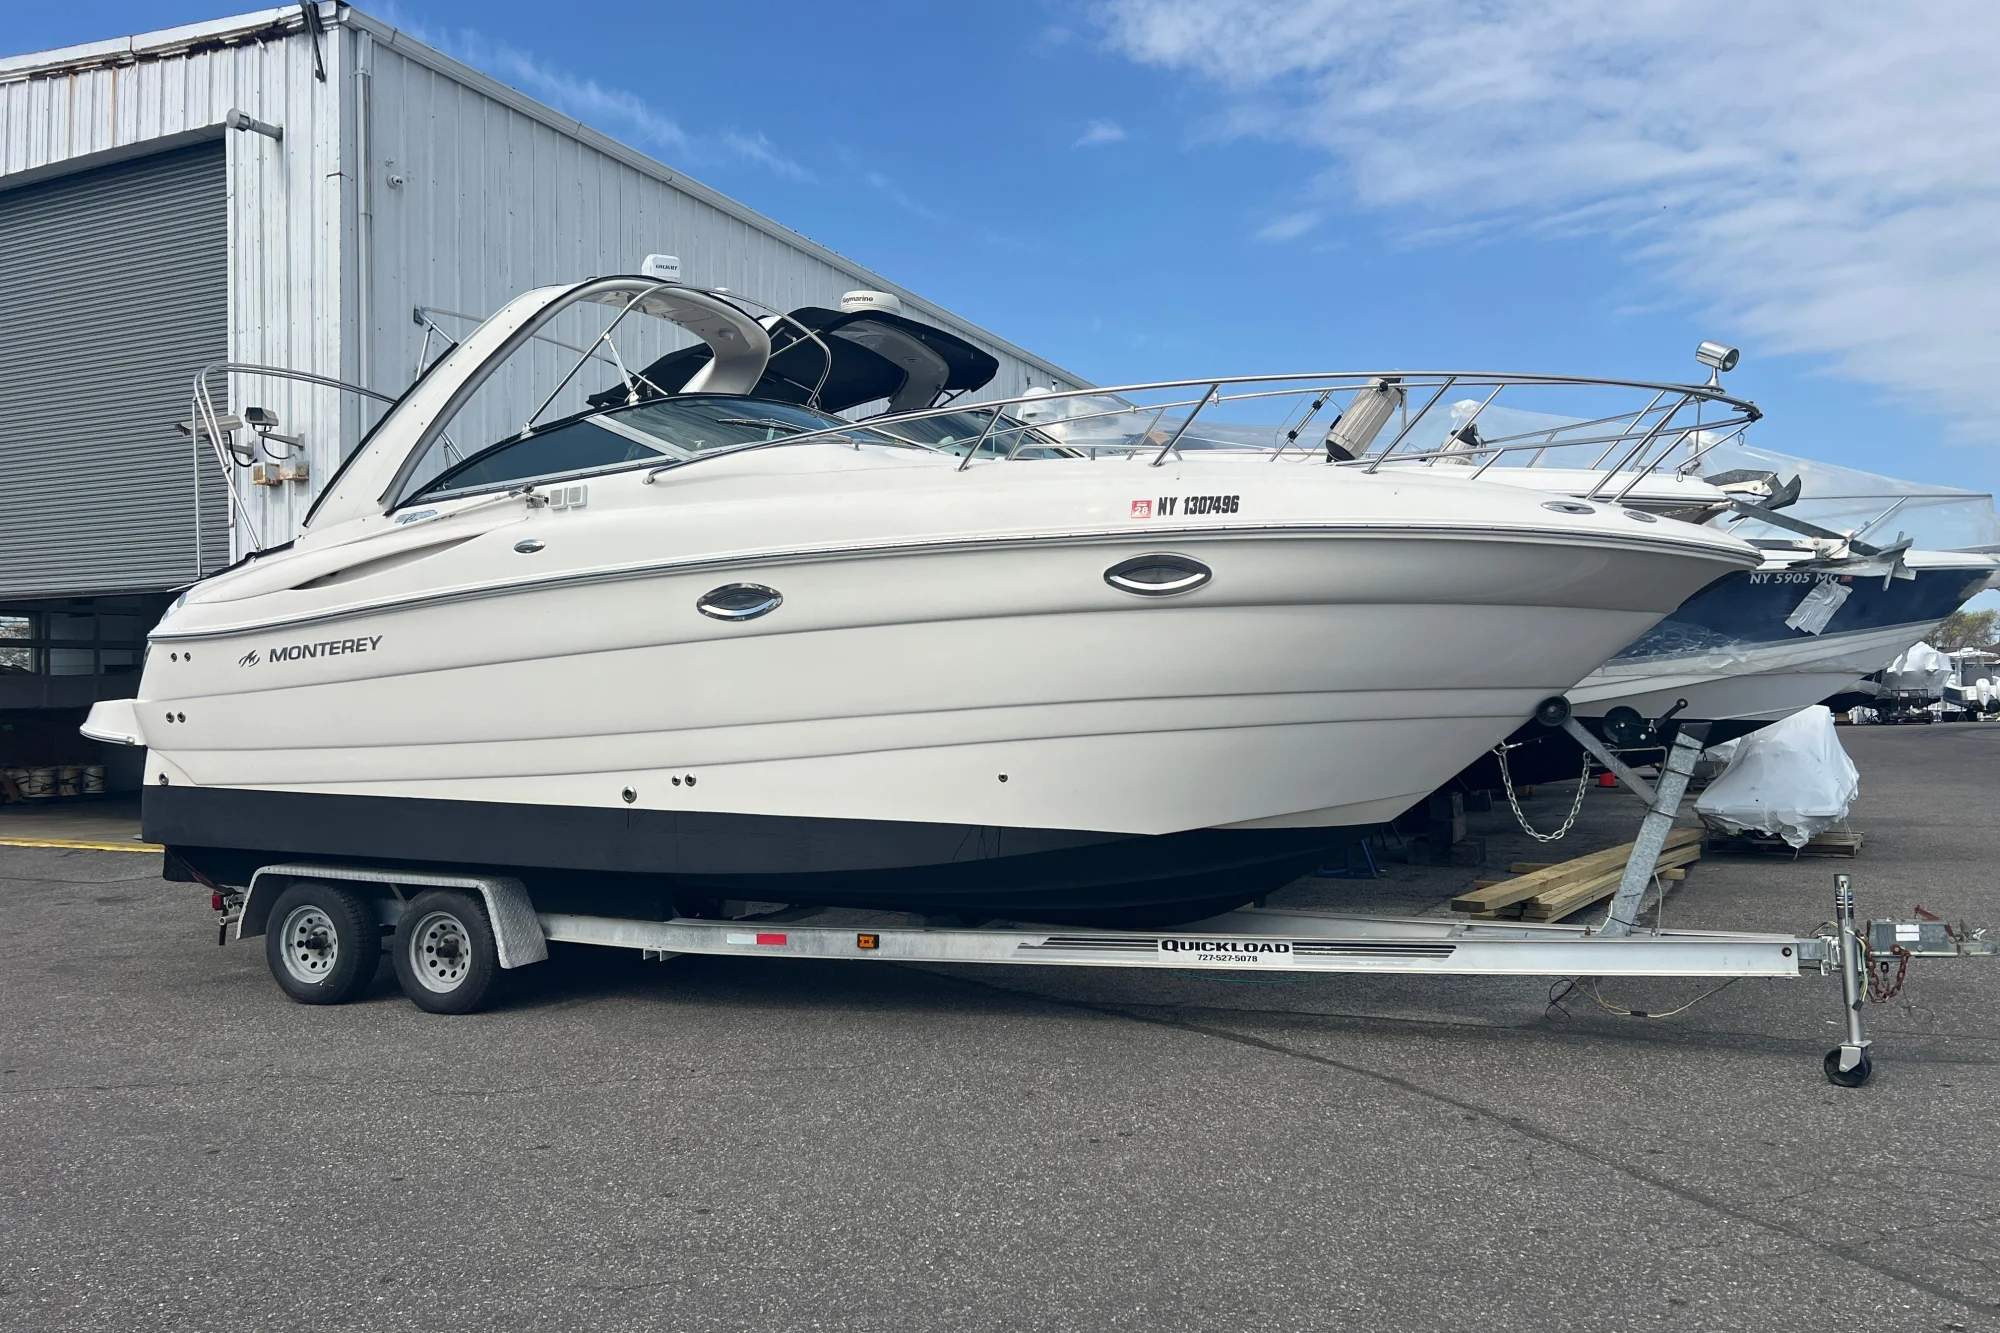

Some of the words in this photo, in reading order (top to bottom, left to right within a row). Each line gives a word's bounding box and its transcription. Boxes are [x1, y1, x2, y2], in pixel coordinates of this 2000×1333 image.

[842, 295, 874, 303] aymarine
[1157, 497, 1178, 516] NY
[1183, 495, 1240, 515] 1307496
[1749, 573, 1772, 585] NY
[1774, 573, 1811, 584] 5905
[269, 635, 383, 663] MONTEREY
[1161, 939, 1290, 954] QUICKLOAD
[1197, 954, 1258, 962] 727-527-5078
